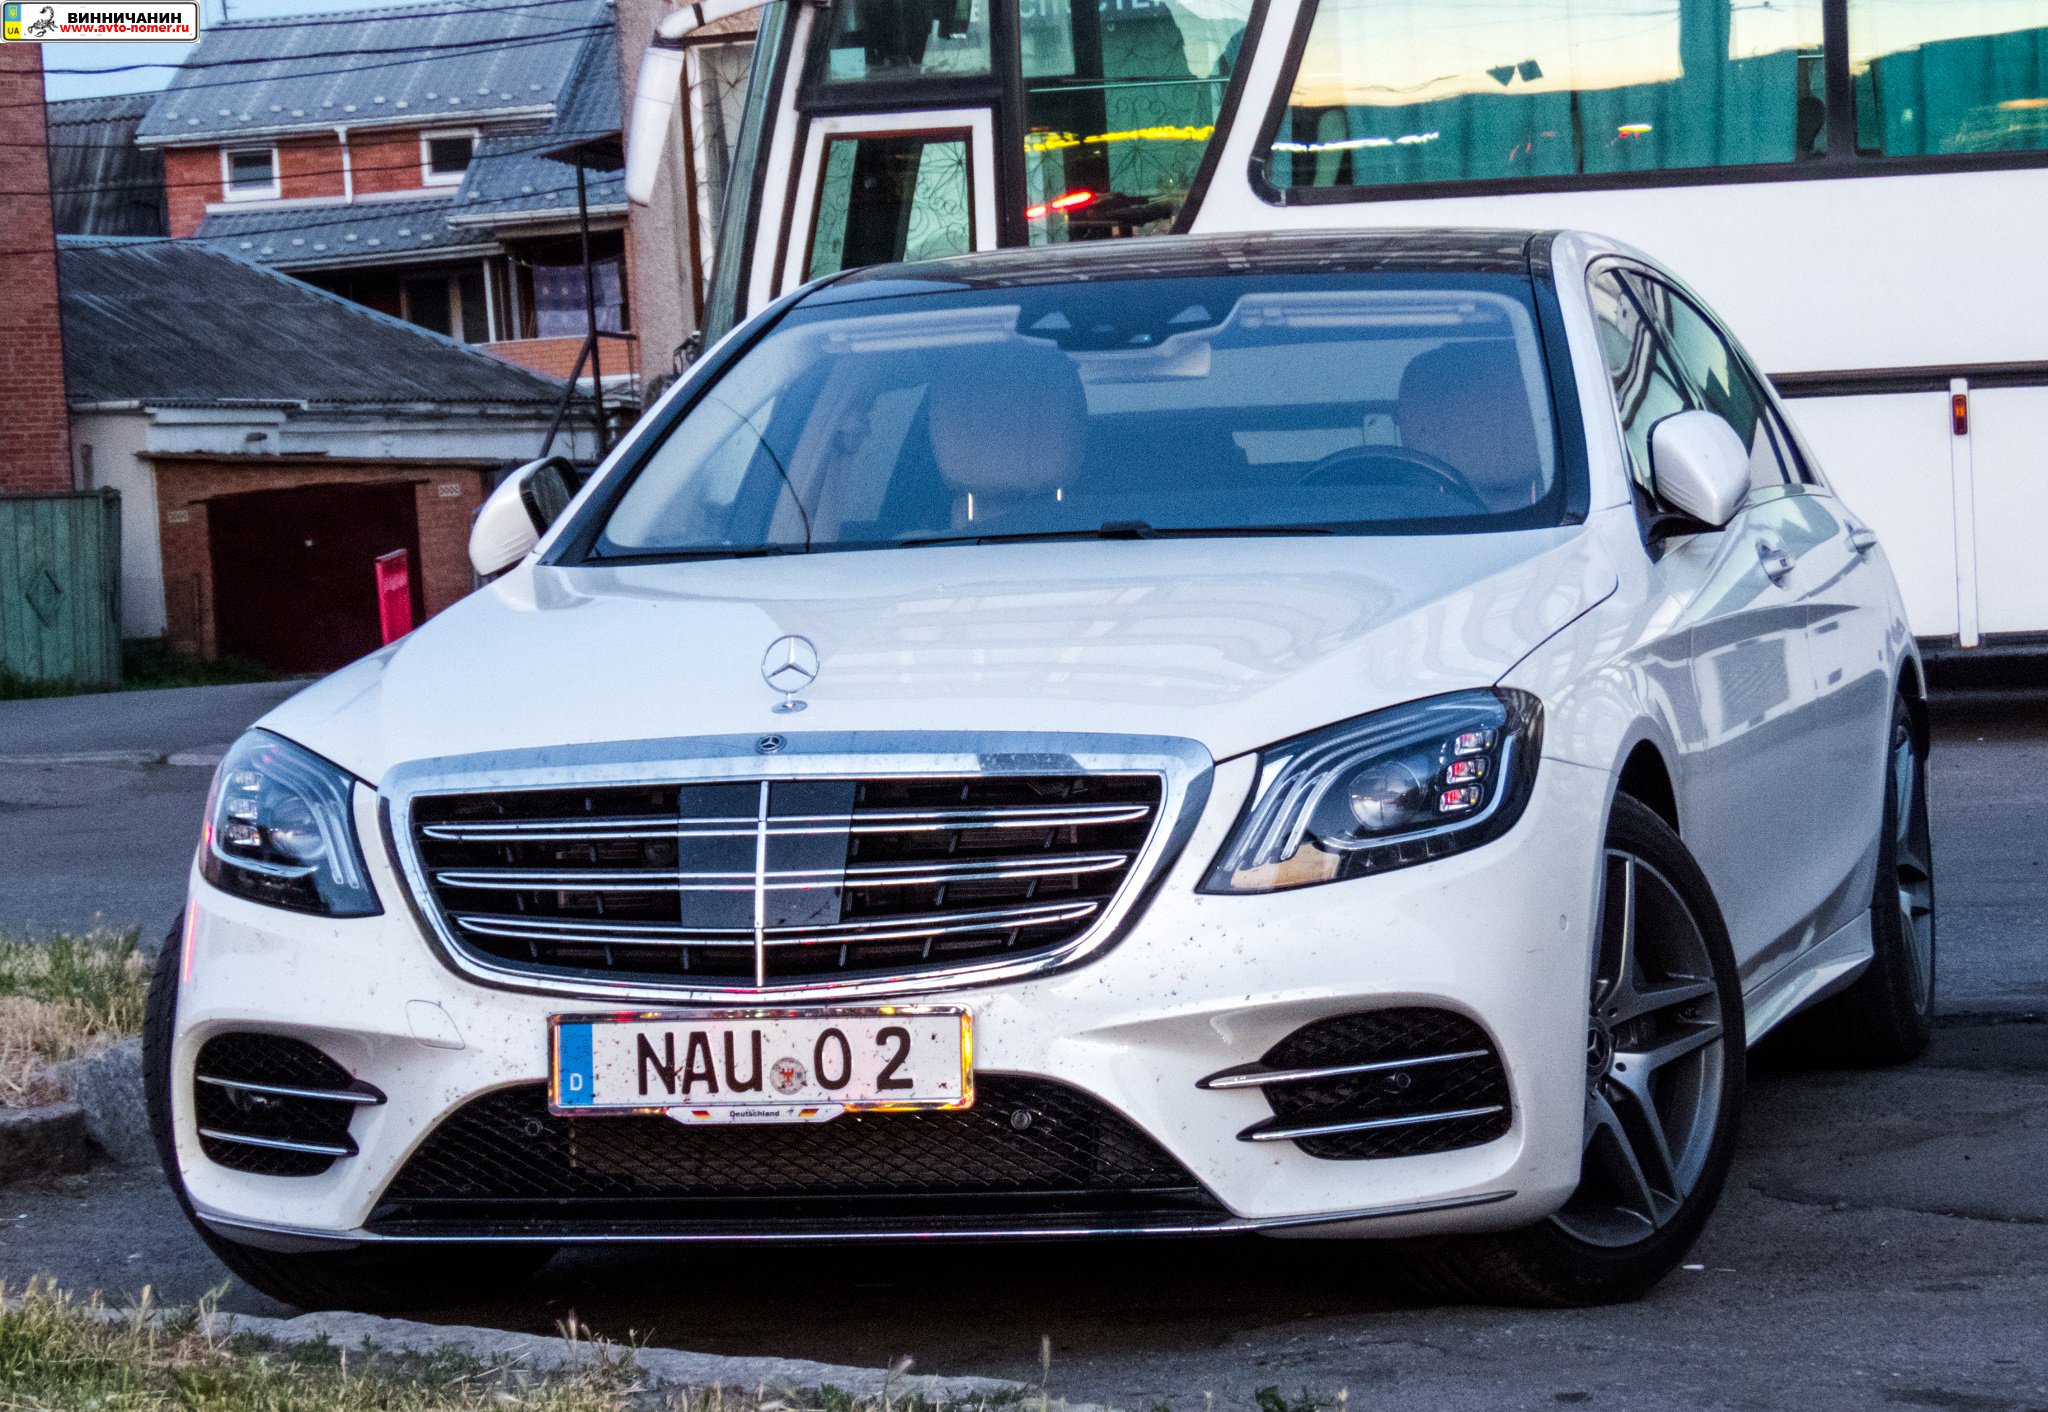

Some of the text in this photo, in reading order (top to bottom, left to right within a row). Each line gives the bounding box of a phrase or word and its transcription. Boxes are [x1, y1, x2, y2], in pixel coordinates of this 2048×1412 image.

[636, 1029, 763, 1096] NAU
[570, 1072, 583, 1091] D
[729, 1110, 780, 1118] Deutschland
